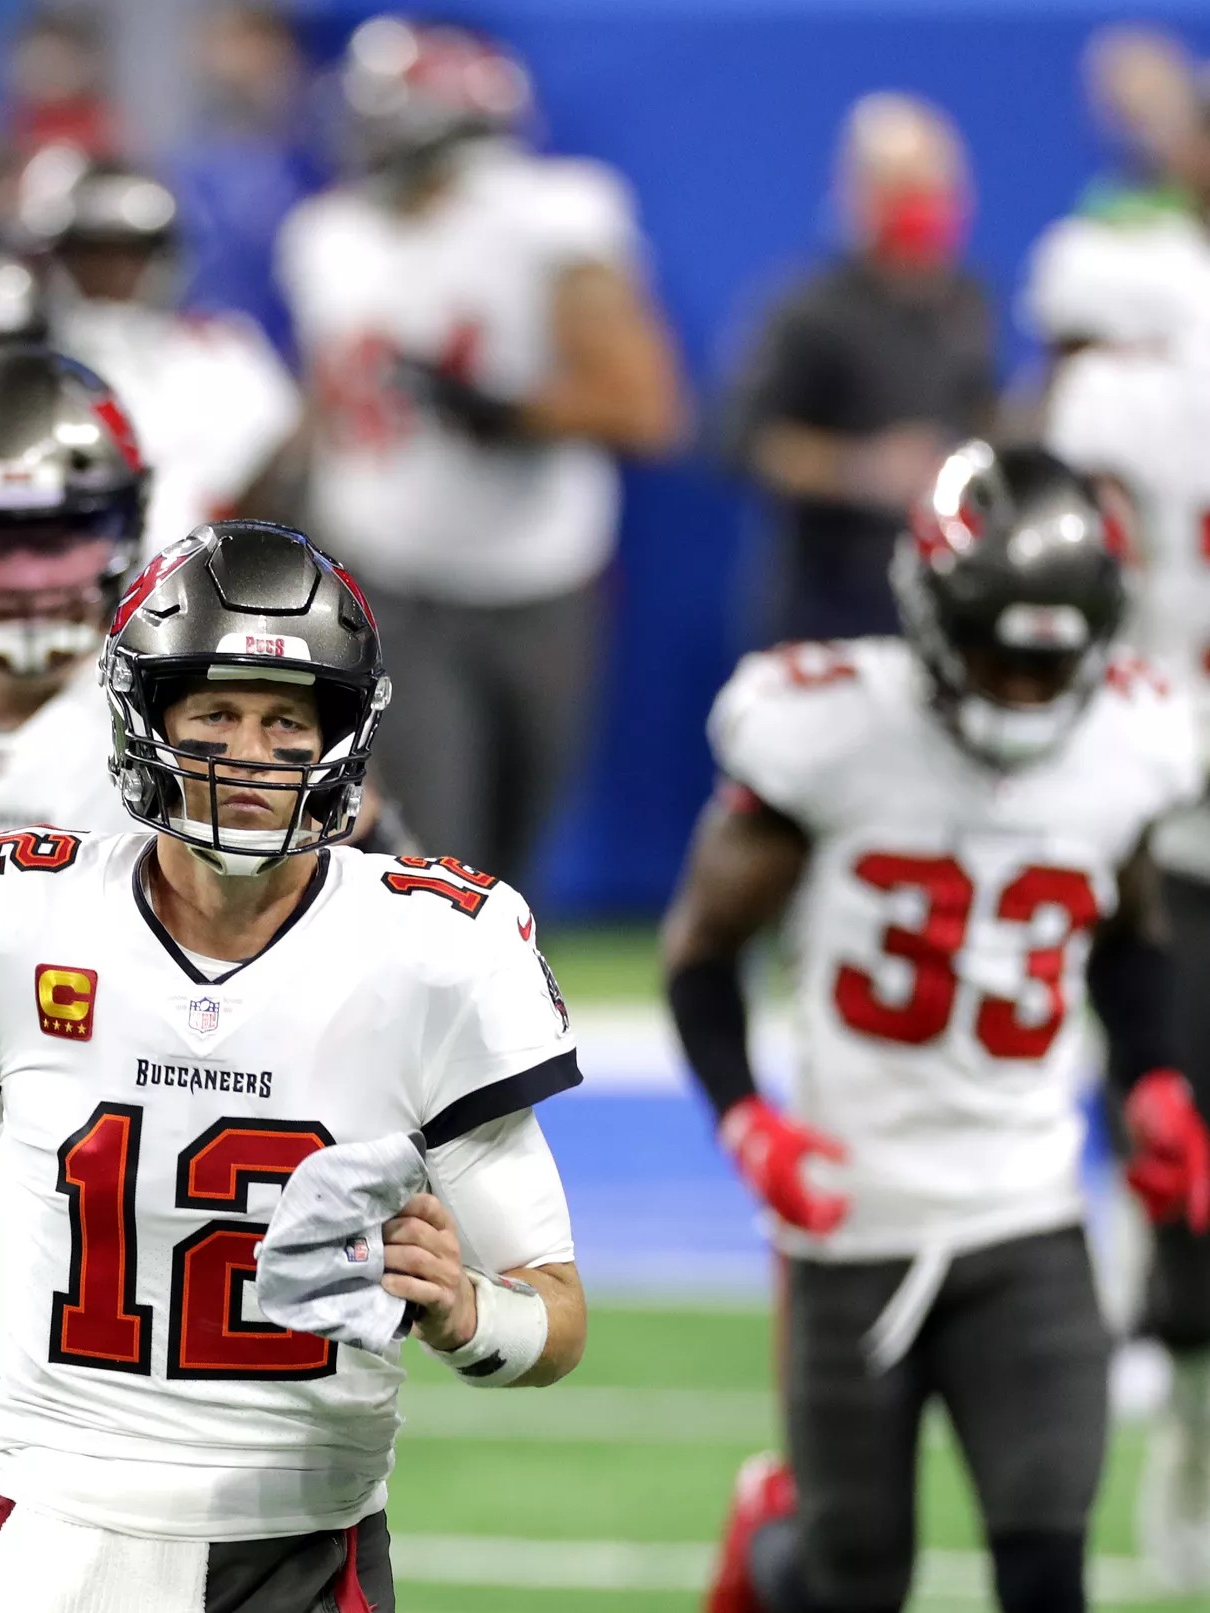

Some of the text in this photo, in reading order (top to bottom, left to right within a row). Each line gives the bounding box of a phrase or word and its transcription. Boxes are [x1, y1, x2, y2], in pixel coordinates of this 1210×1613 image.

[38, 969, 91, 1022] C
[834, 852, 1099, 1060] 33
[136, 1058, 272, 1098] BUCCANEERS
[48, 1101, 338, 1381] 12
